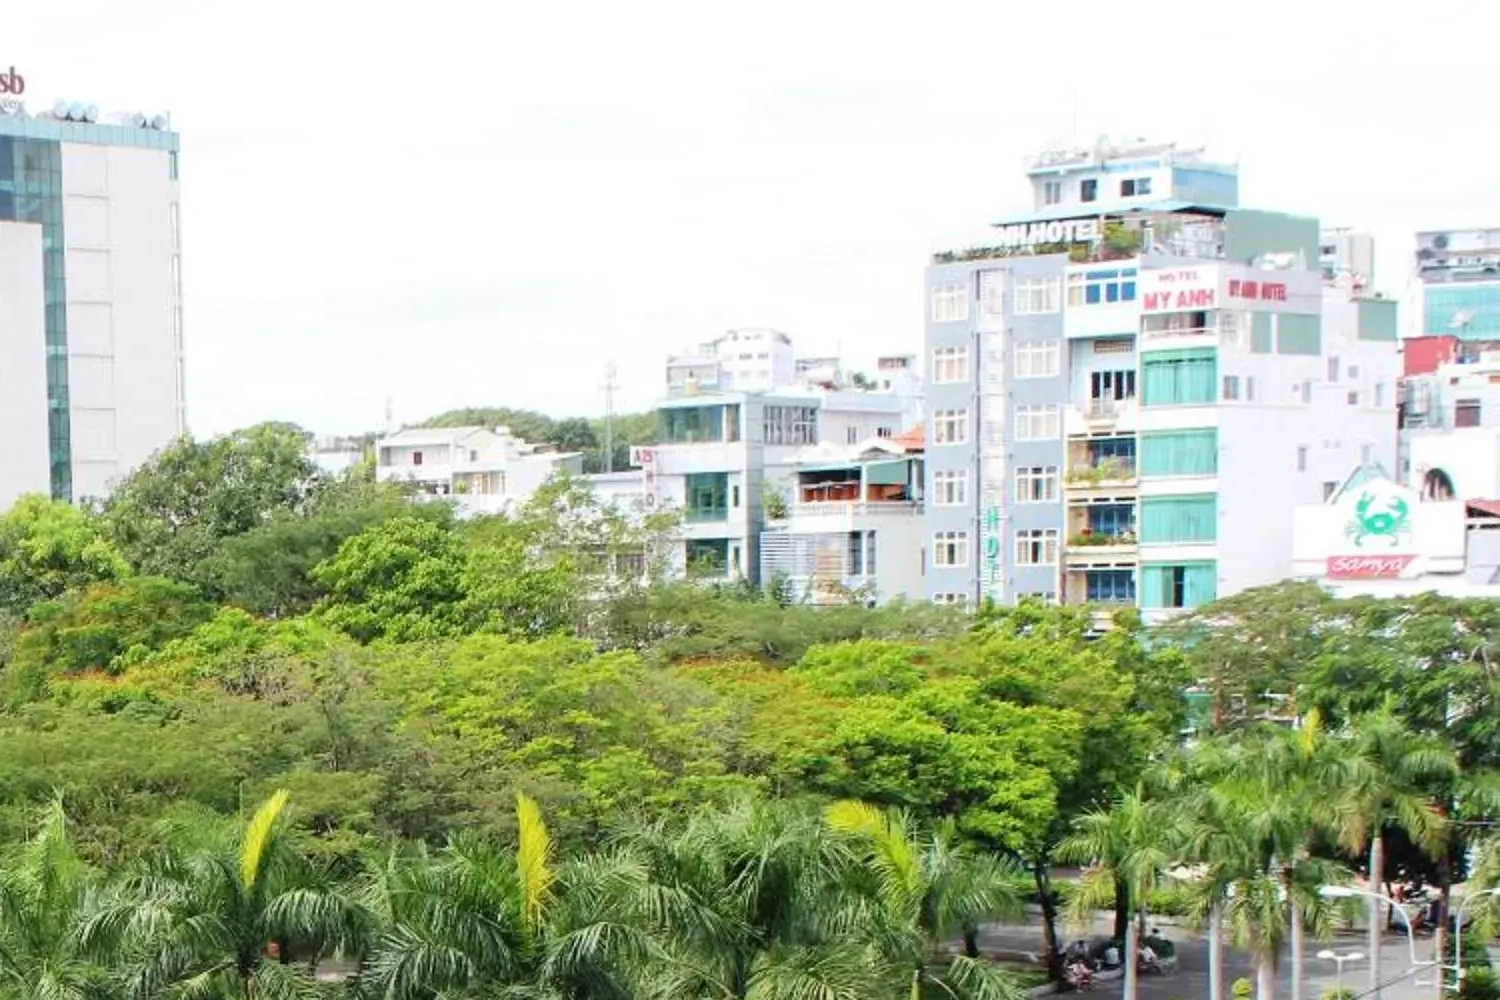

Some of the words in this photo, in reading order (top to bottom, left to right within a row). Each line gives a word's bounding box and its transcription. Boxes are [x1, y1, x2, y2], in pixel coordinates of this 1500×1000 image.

[1029, 218, 1102, 244] HOTEL
[1158, 271, 1198, 282] HOTEL
[1176, 288, 1215, 308] ANH
[1262, 283, 1287, 300] HOTEL
